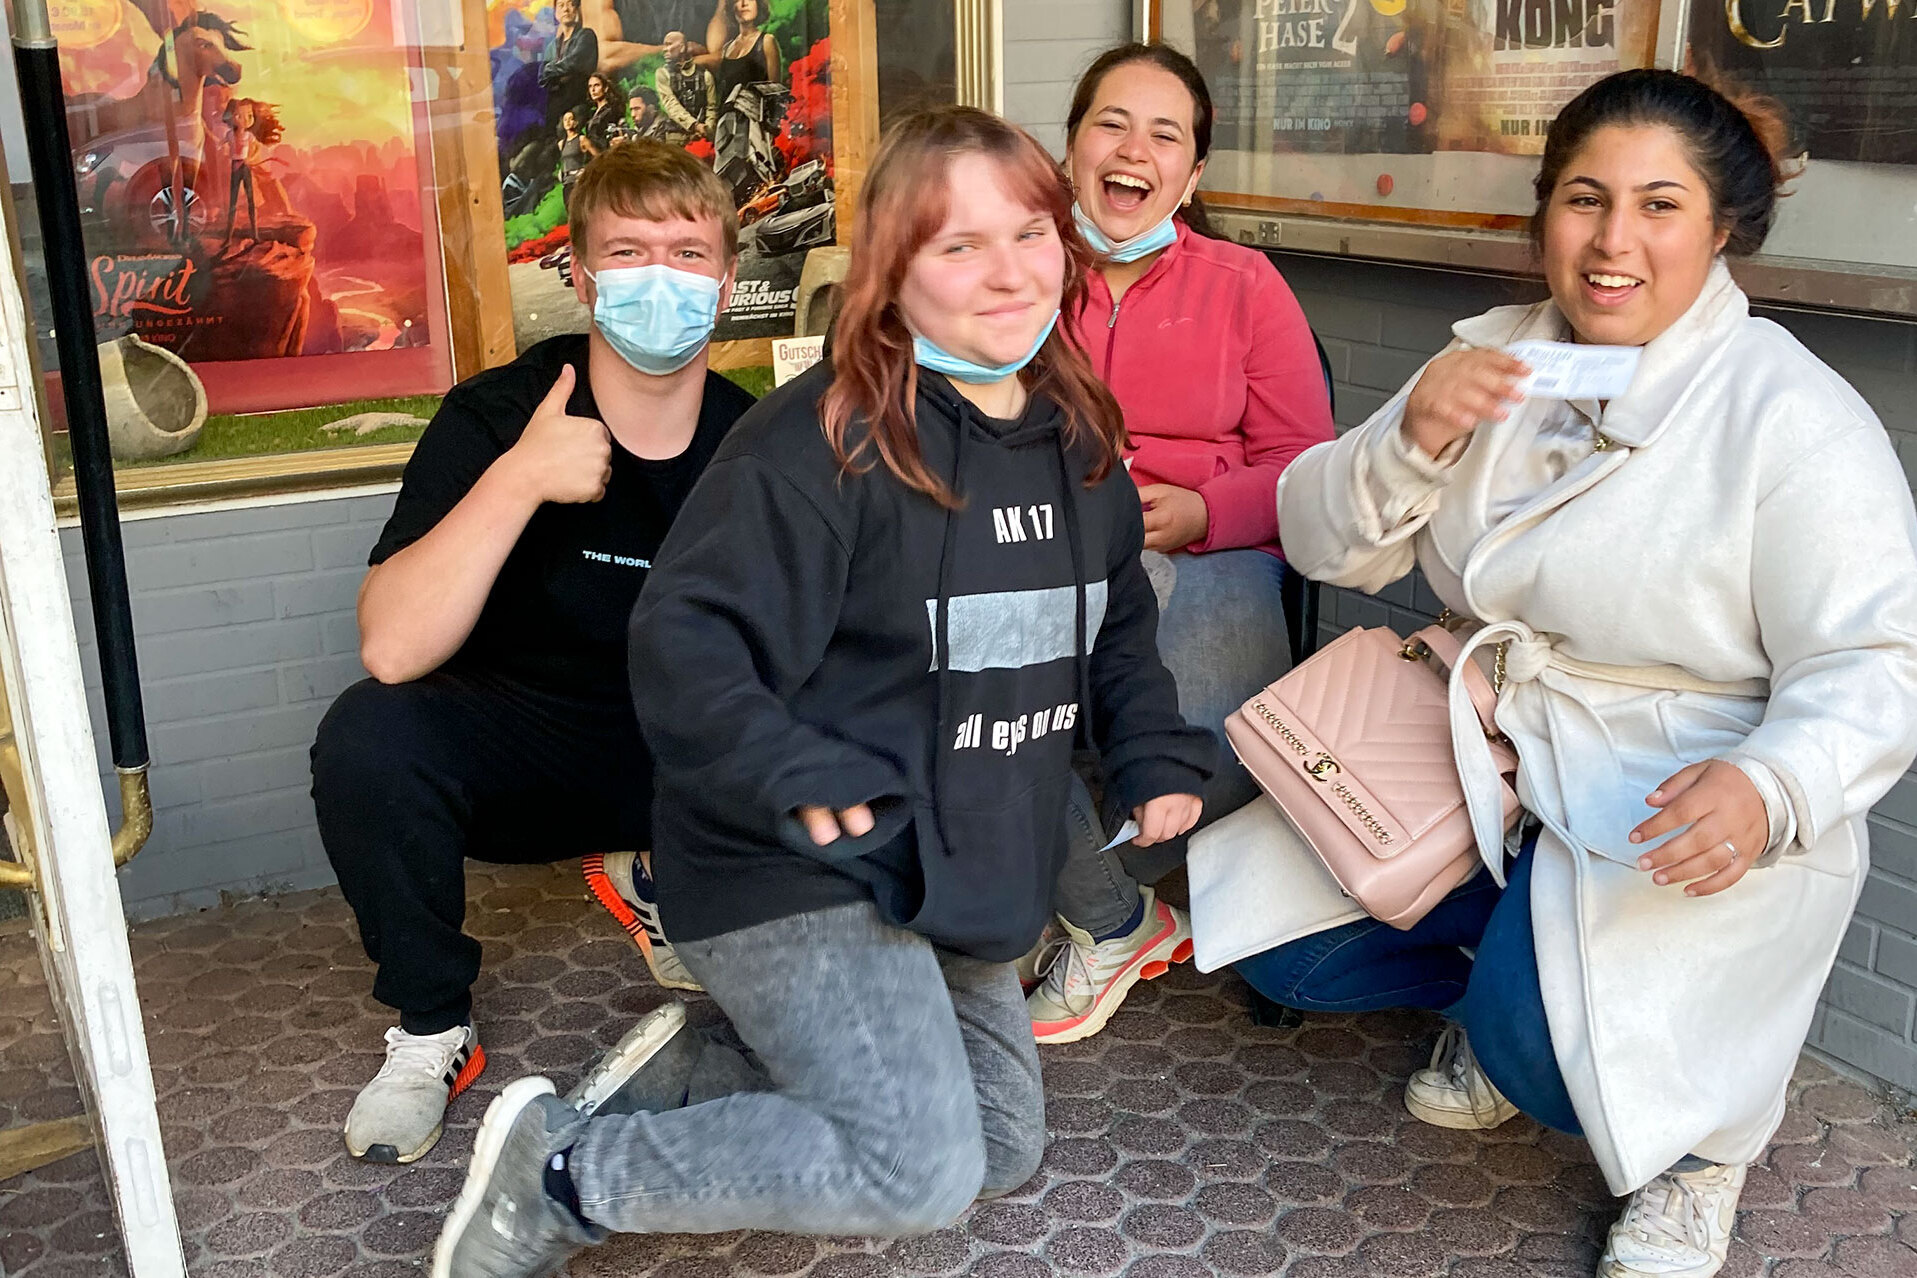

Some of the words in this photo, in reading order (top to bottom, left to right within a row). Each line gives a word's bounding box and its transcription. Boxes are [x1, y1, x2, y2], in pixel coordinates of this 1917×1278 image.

[1259, 18, 1326, 53] HASE
[1493, 0, 1615, 51] KONG
[1273, 118, 1293, 130] NUR
[1307, 118, 1331, 130] KINO
[1501, 119, 1531, 136] NUR
[91, 255, 198, 317] Spirit
[730, 290, 792, 307] URIOUS
[992, 505, 1028, 544] AK
[1028, 503, 1054, 541] 17
[582, 550, 611, 563] THE
[613, 555, 652, 569] WORL
[953, 713, 983, 750] all
[1052, 702, 1079, 731] us
